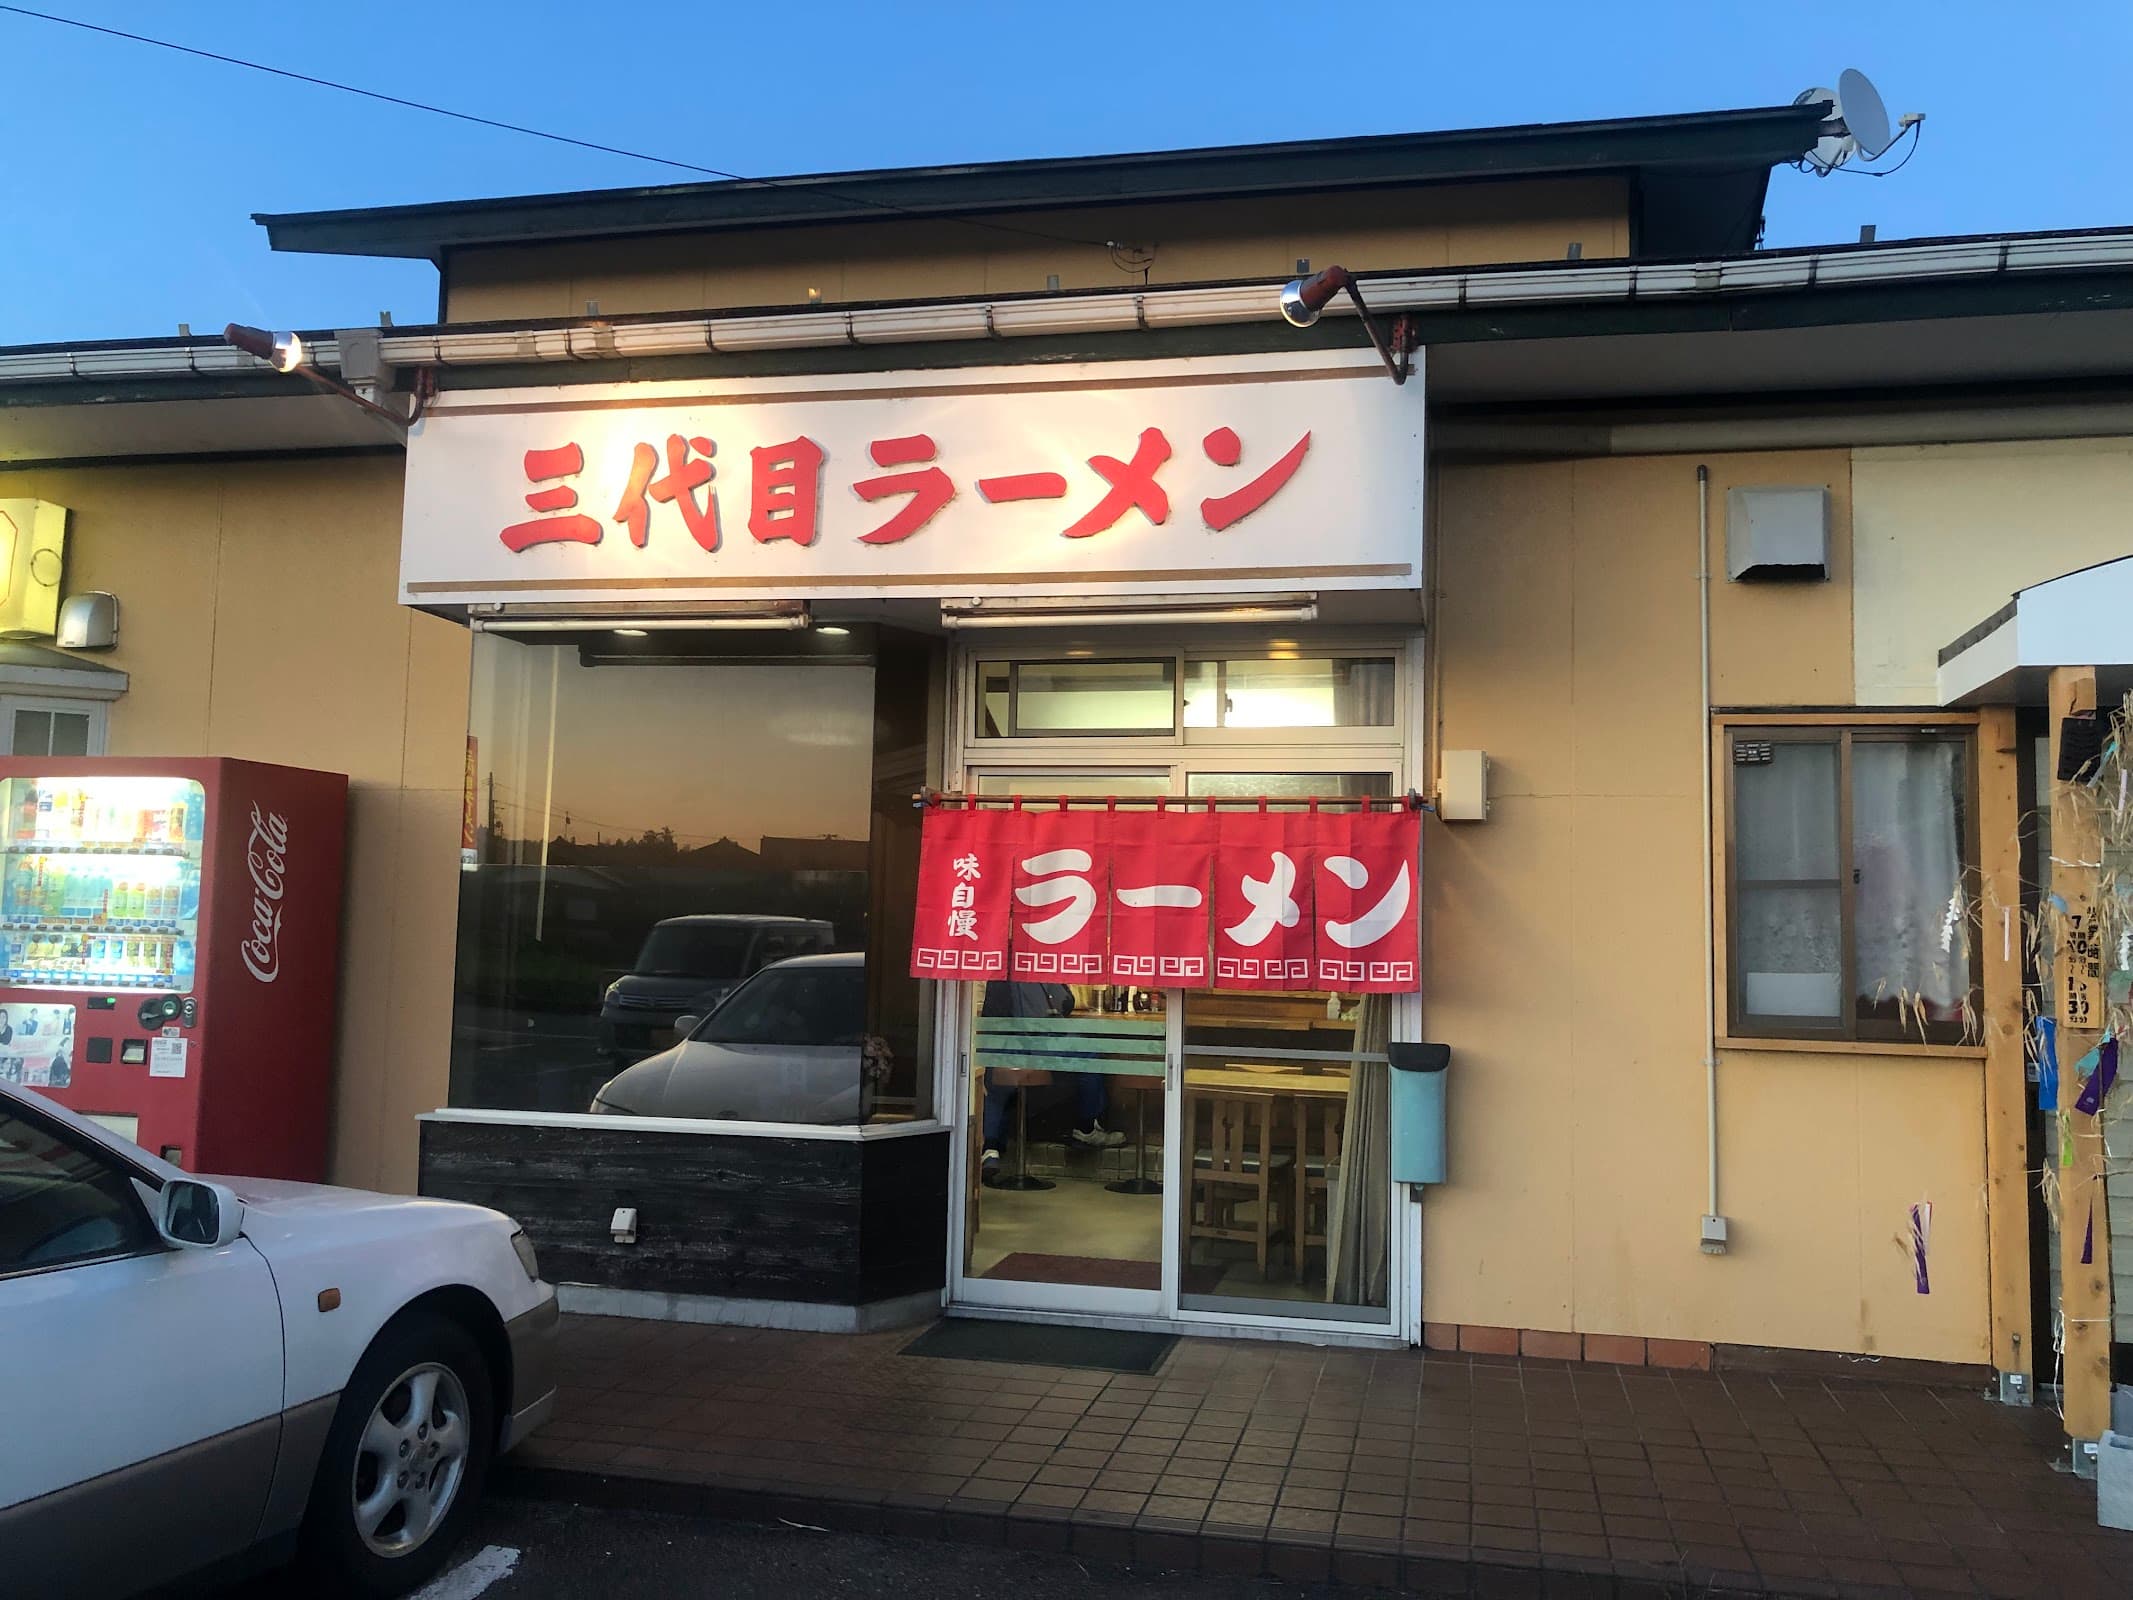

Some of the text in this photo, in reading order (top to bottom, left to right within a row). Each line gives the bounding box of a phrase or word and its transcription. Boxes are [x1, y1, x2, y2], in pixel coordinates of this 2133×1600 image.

[500, 426, 1311, 553] 三代目ラーメン
[240, 799, 289, 983] Coca-Cola
[947, 852, 982, 941] 味自慢
[1014, 848, 1412, 948] ラーメン
